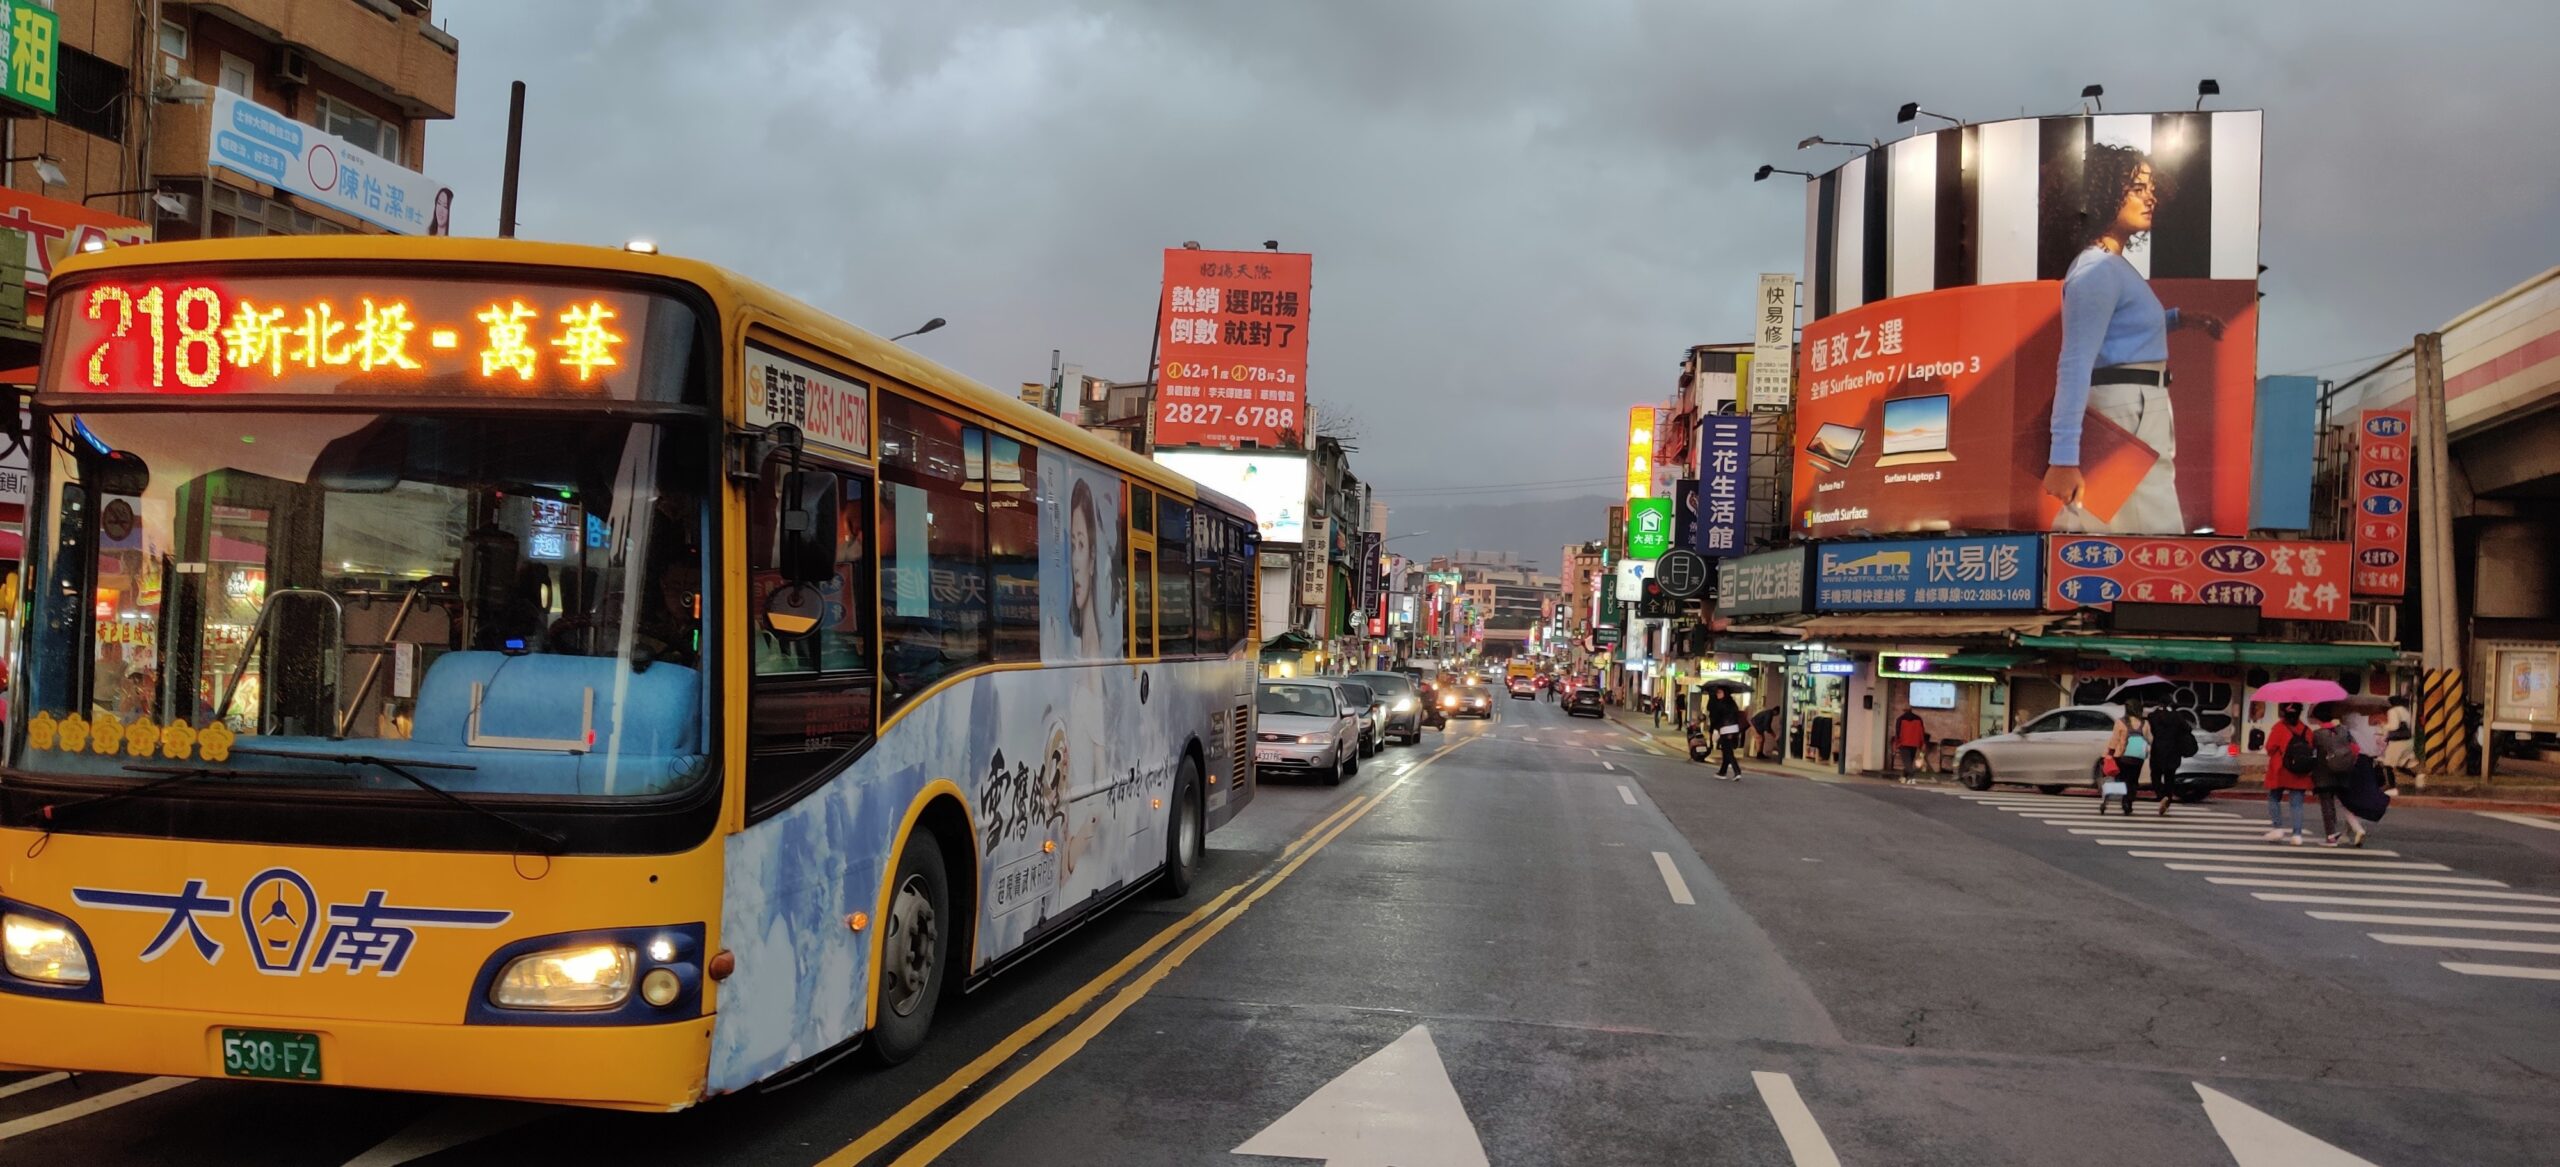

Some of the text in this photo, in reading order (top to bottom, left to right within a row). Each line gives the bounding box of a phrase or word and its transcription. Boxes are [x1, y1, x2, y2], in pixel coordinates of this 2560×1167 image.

[13, 8, 52, 101] 租
[340, 164, 405, 219] 陳怡潔
[1172, 286, 1298, 317] 熱銷 選昭揚
[1765, 286, 1784, 344] 快易修
[1170, 318, 1296, 348] 倒數 就對了
[1811, 319, 1904, 373] 極致之選
[1811, 380, 1829, 401] 全新
[1830, 374, 1864, 395] Surface
[1866, 369, 1885, 386] Pro
[1888, 365, 1896, 383] 7
[1908, 360, 1964, 382] Laptop
[1969, 355, 1980, 373] 3
[765, 364, 867, 448] 摩菲爾 2351-0578
[1164, 403, 1294, 428] 2827-6788
[2369, 420, 2402, 432] 旅行箱
[2368, 446, 2401, 459] 女用包
[1709, 424, 1738, 549] 三花生活館
[1884, 473, 1907, 484] Surface
[1908, 473, 1934, 483] Laptop
[2368, 473, 2400, 486] 公事包
[1813, 506, 1869, 524] Microsoft Surface
[1926, 544, 2019, 583] 快易修
[2066, 546, 2119, 565] 旅行箱
[2136, 547, 2188, 567] 女用包
[2208, 550, 2258, 570] 公事包
[2271, 546, 2327, 577] 宏富
[1738, 560, 1802, 601] 三花生活館
[2207, 585, 2257, 605] 生活百貨
[2285, 581, 2341, 614] 皮件
[225, 1038, 318, 1074] 538-FZ
